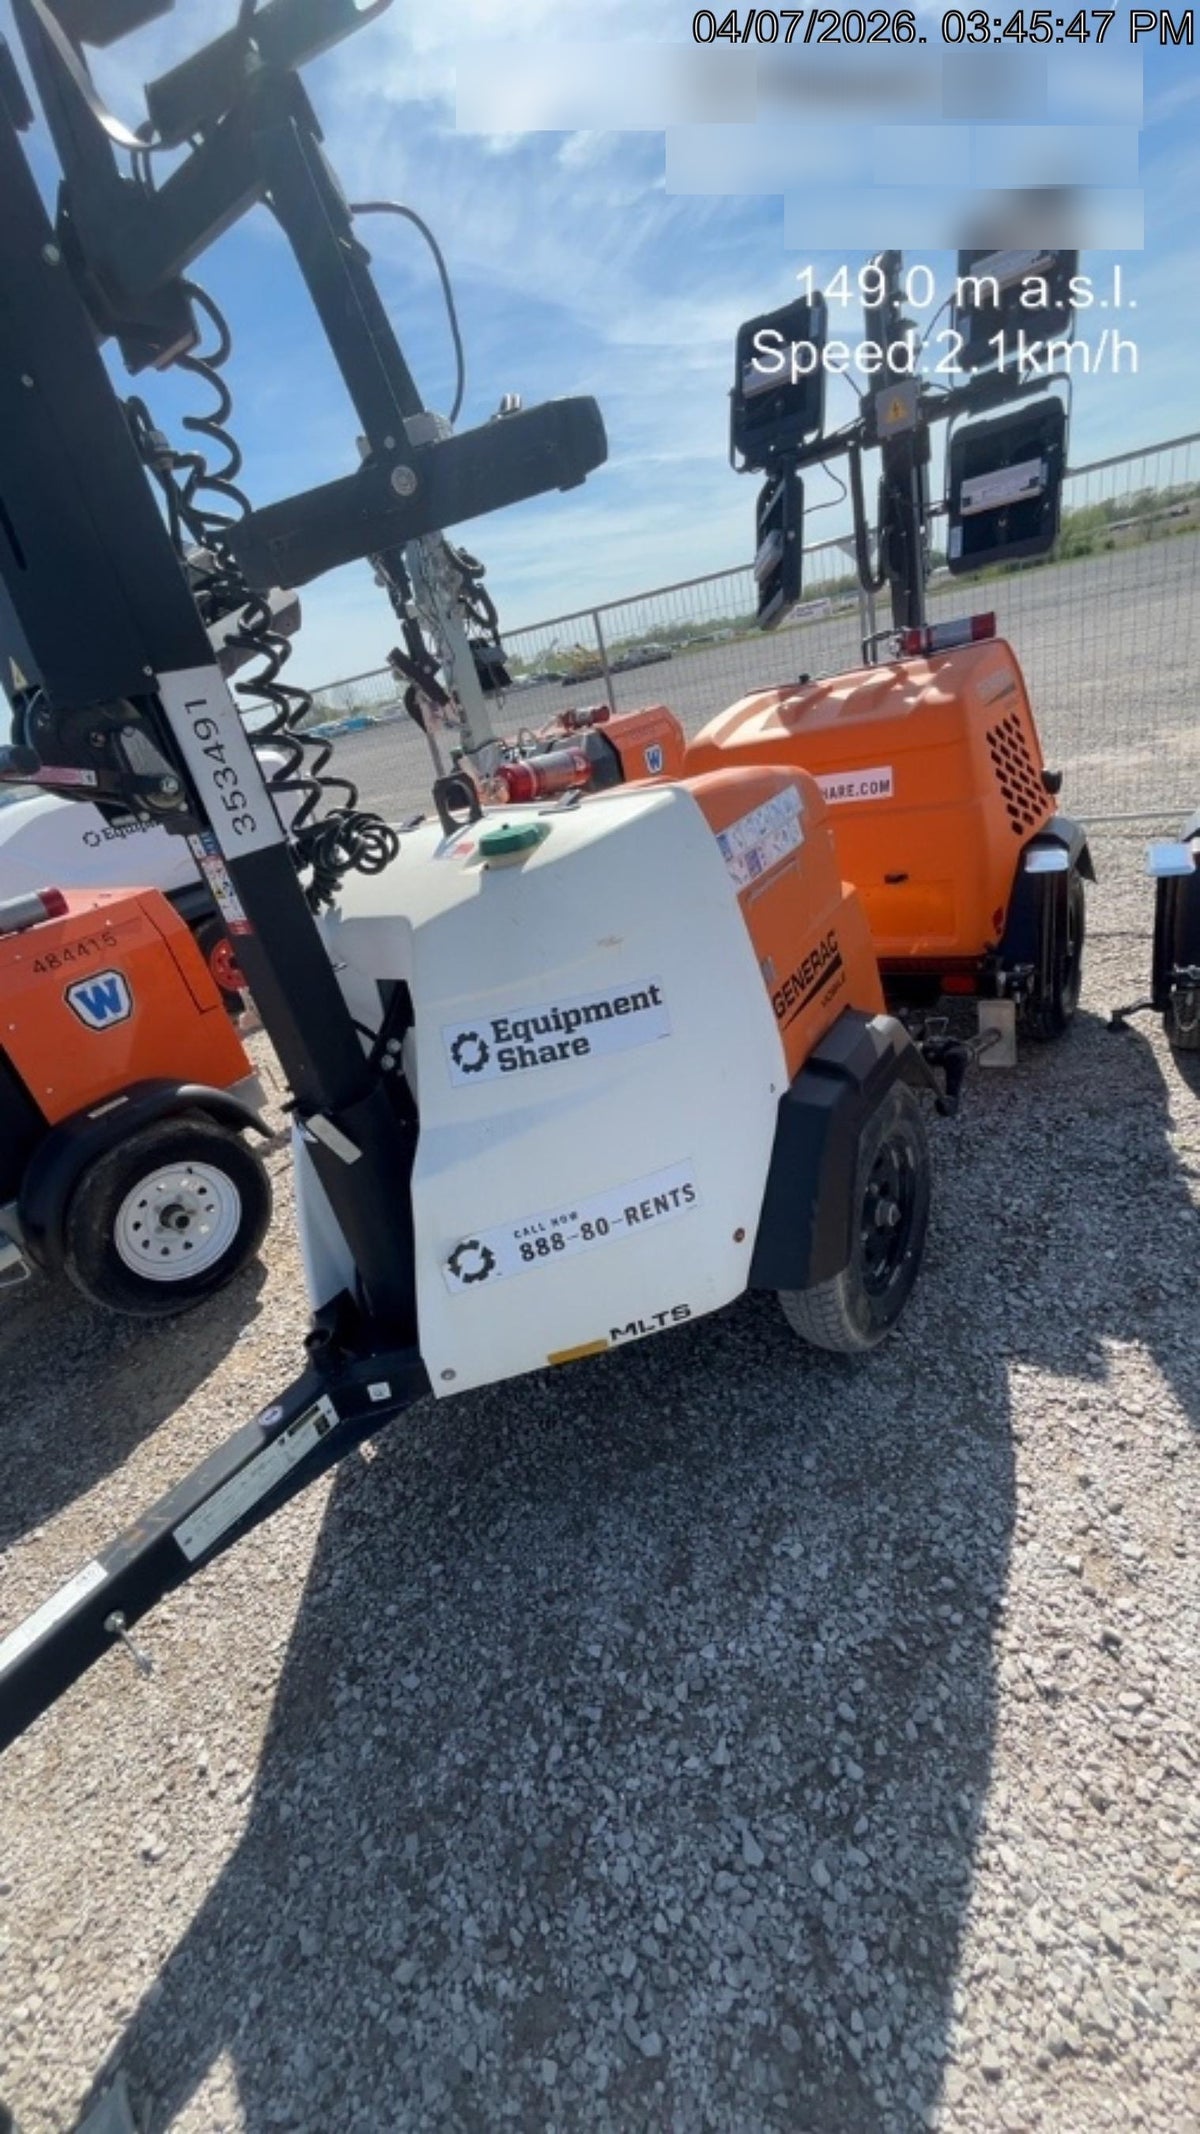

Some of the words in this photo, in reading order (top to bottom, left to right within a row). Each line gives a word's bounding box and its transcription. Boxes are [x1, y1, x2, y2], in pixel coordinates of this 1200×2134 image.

[184, 698, 257, 836] 353491
[32, 930, 118, 974] 484415
[772, 929, 839, 1019] GENERAC
[73, 977, 123, 1021] W
[490, 984, 663, 1044] Equipment
[496, 1035, 591, 1073] Share
[513, 1221, 546, 1239] CALL
[550, 1210, 579, 1228] NOW
[518, 1182, 697, 1262] 888-80-RENTS
[608, 1303, 692, 1341] MLTS
